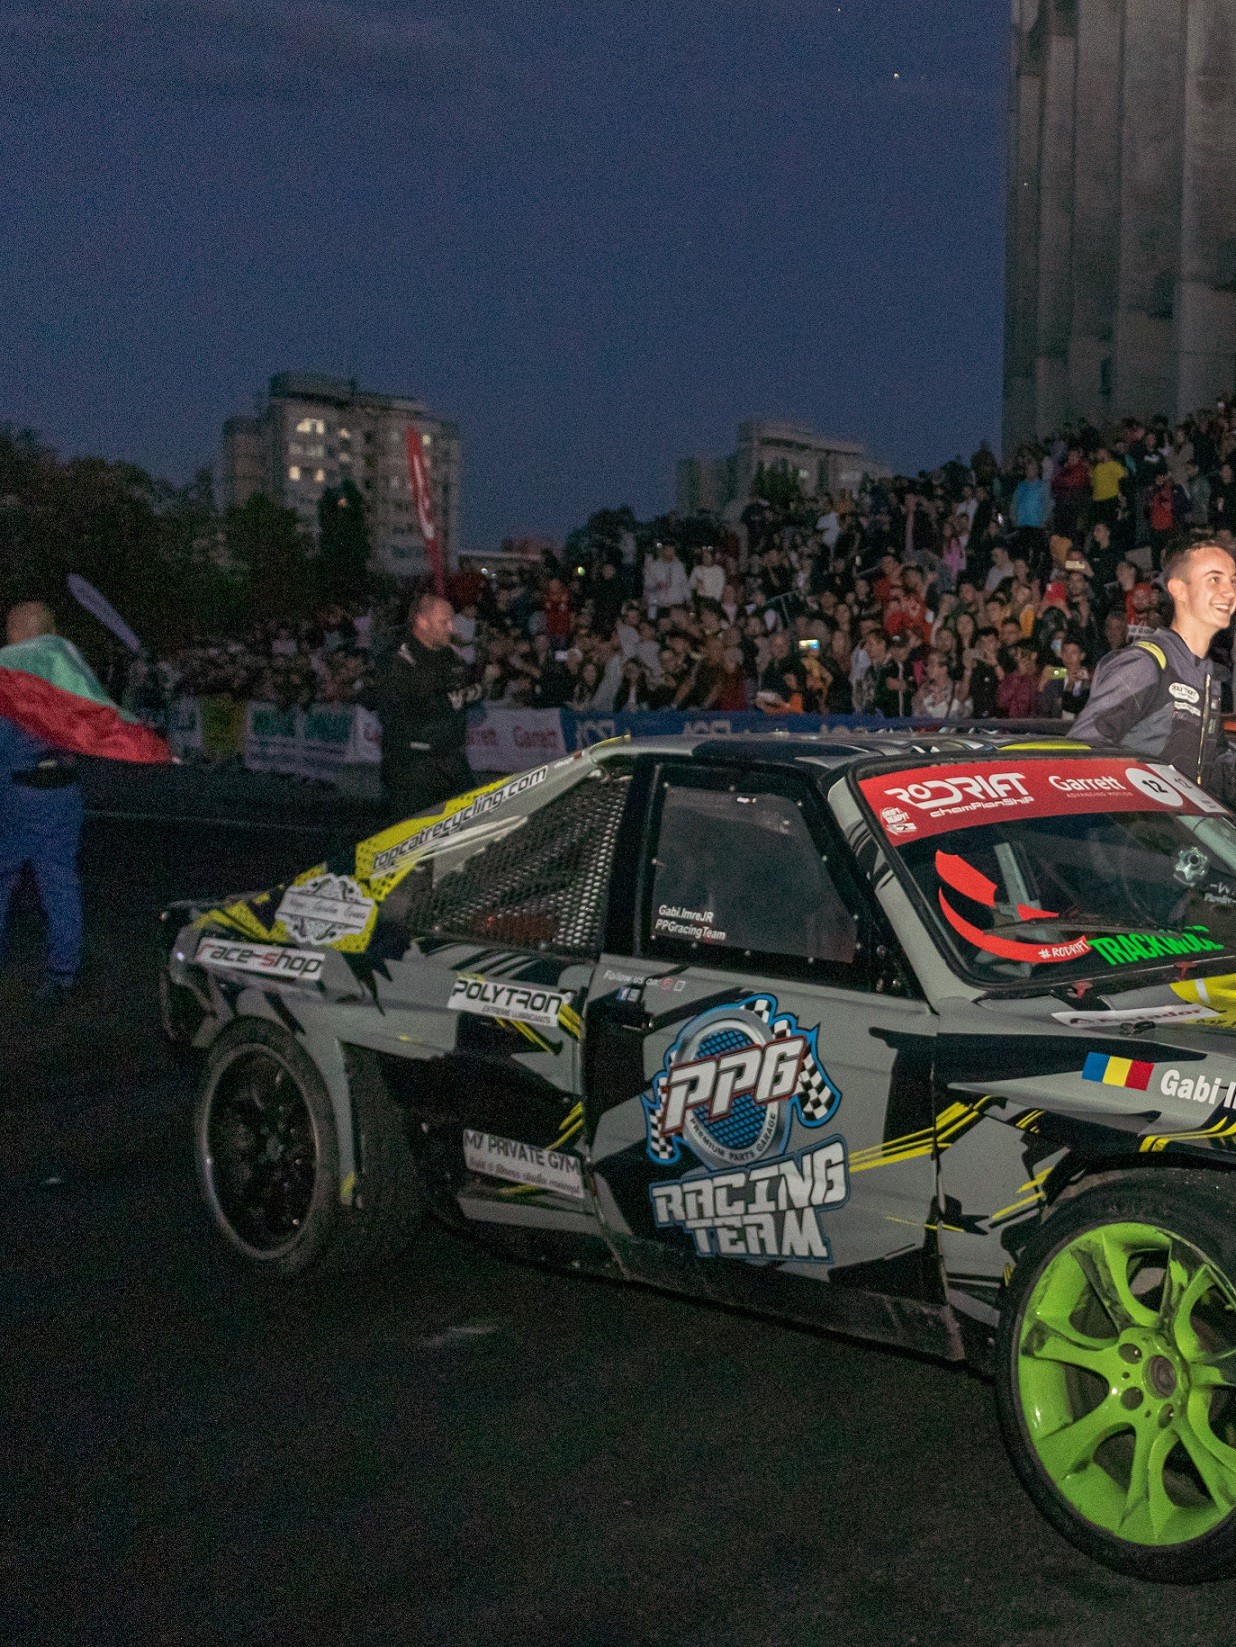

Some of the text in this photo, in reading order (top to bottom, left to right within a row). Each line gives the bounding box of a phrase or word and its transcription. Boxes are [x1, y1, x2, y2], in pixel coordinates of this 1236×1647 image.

[1048, 774, 1127, 793] Garrett
[1144, 779, 1169, 794] 12
[370, 763, 549, 870] topcatrecycling.com
[195, 943, 323, 977] race-shop
[452, 978, 564, 1015] POLYTRON
[660, 1036, 805, 1135] PPG
[1160, 1069, 1220, 1105] Gabi
[488, 1135, 545, 1167] PRIVATE
[547, 1150, 579, 1174] GYM
[690, 1112, 777, 1161] PREMIUM PARTS GARAGE
[653, 1142, 847, 1223] RACING
[694, 1206, 829, 1260] TEAM
